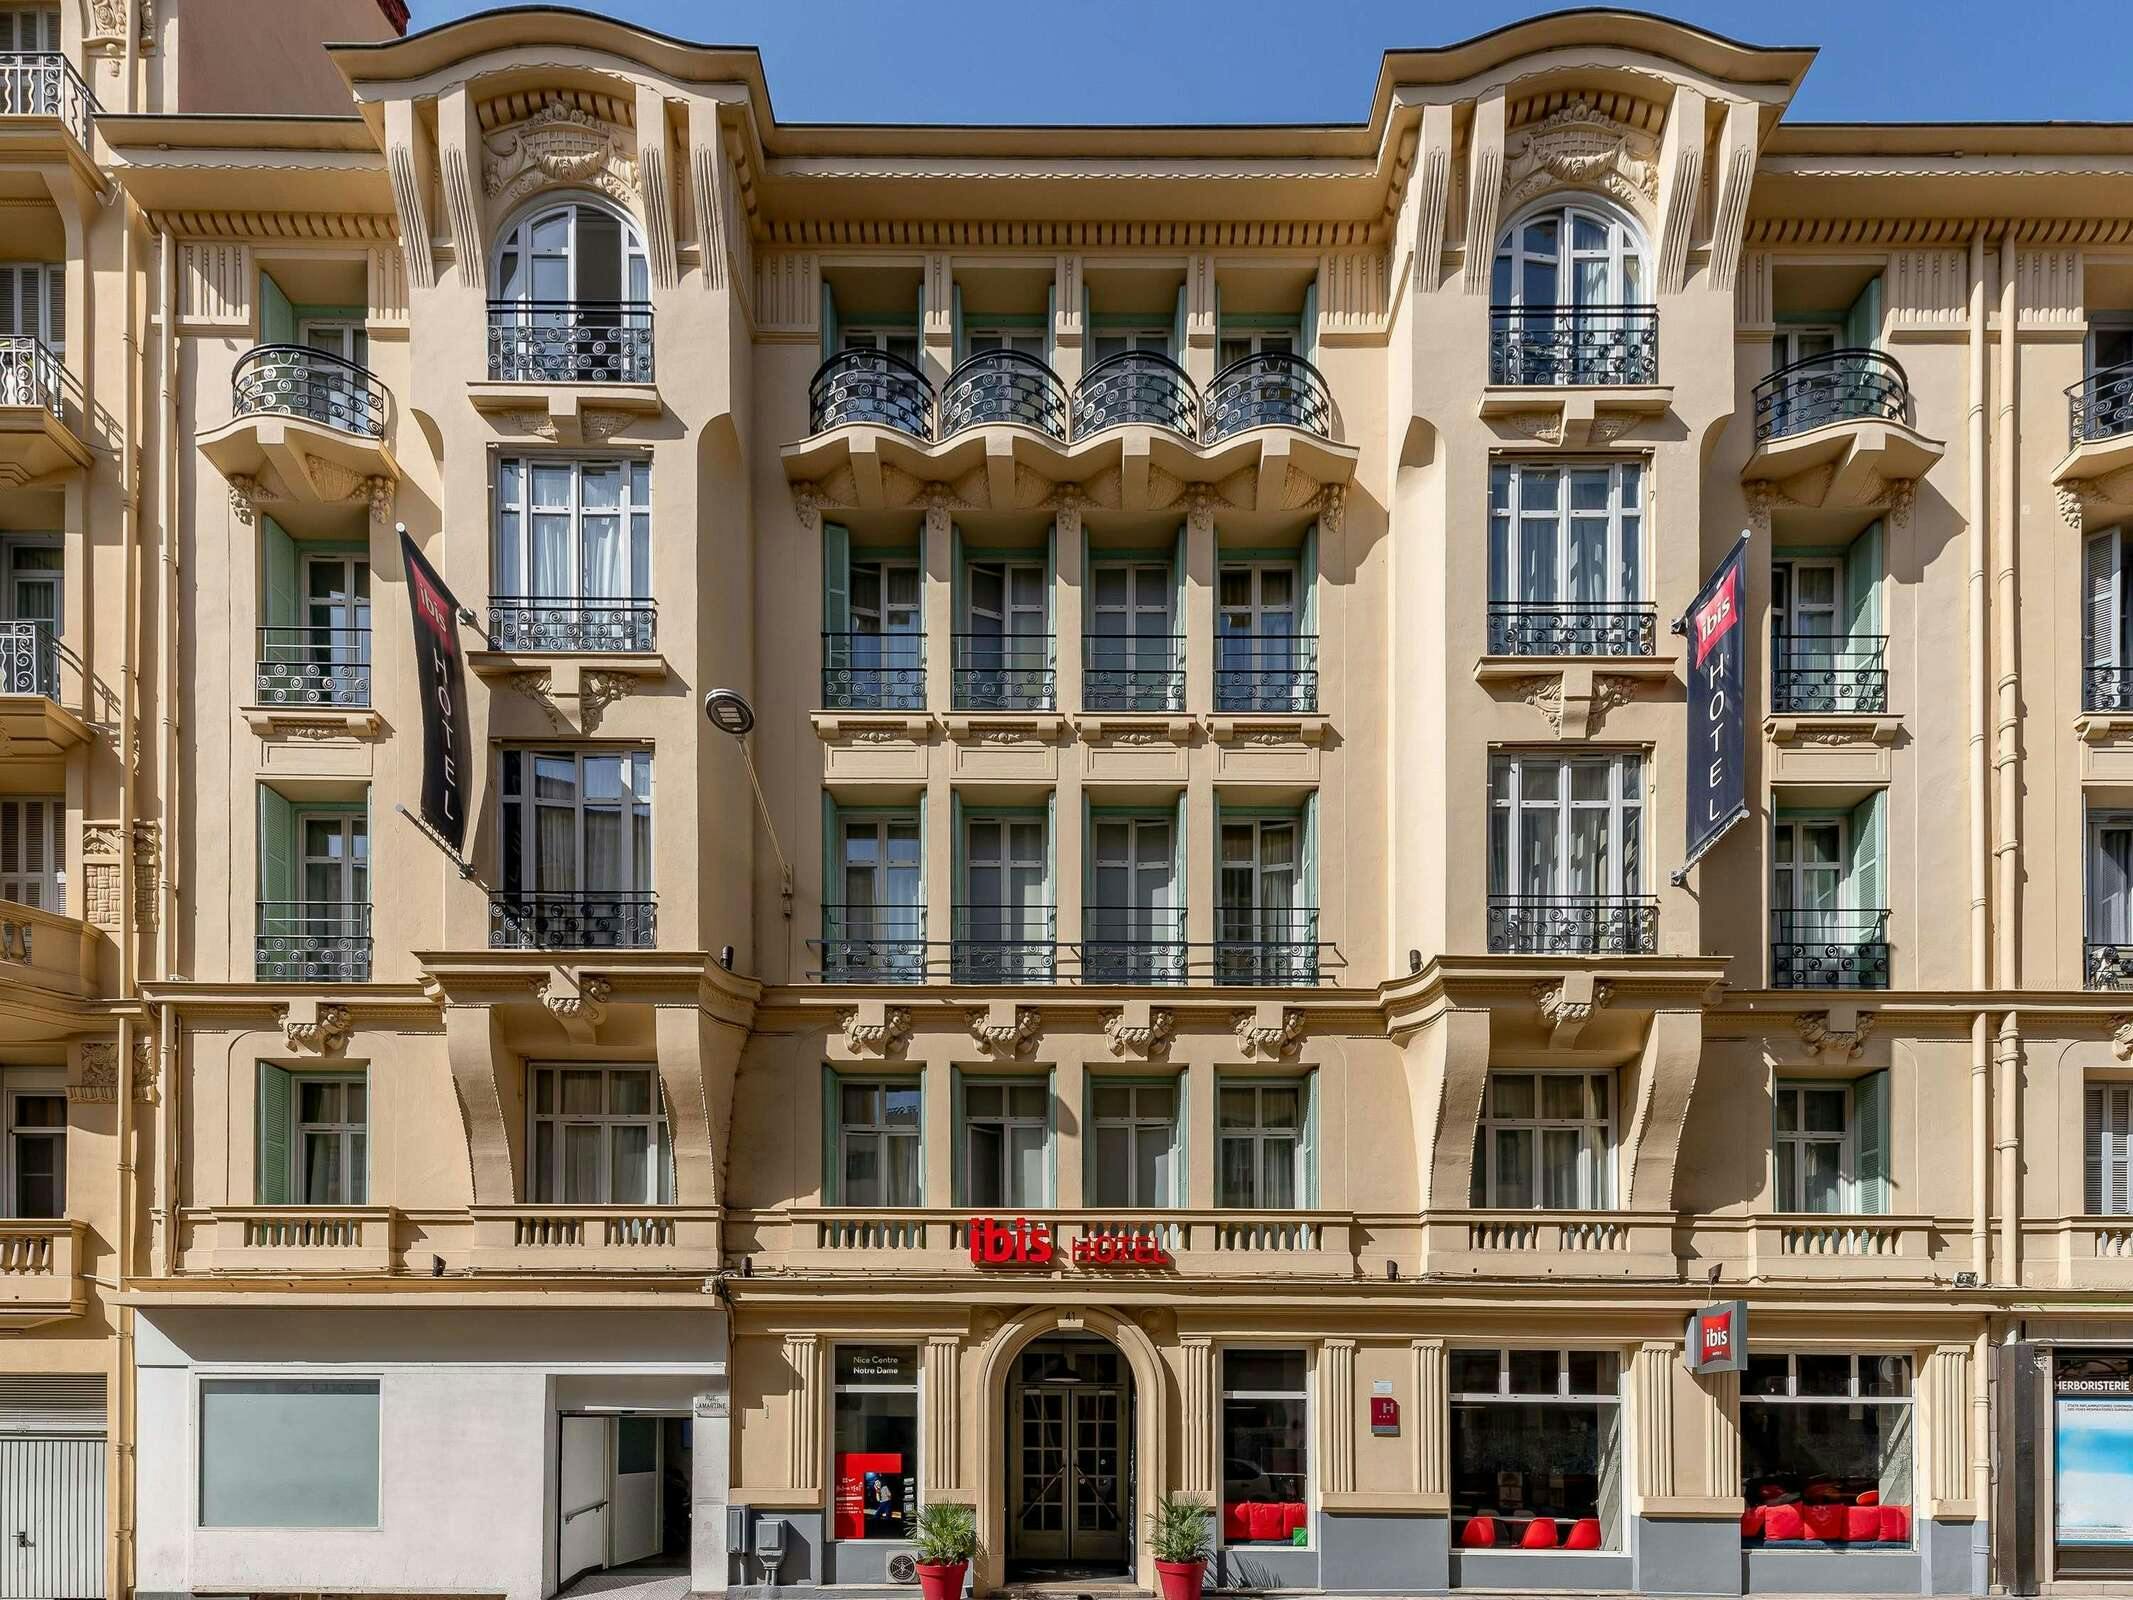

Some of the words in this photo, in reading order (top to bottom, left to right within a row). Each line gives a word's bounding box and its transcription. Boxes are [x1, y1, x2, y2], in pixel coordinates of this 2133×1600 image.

[419, 582, 447, 633] ibis
[1701, 596, 1731, 642] ibis
[433, 647, 456, 821] HOTEL
[1709, 652, 1725, 821] HOTEL
[969, 1217, 1053, 1263] ibis
[1072, 1236, 1168, 1263] HOTEL
[872, 1356, 898, 1364] Centre
[1706, 1327, 1728, 1348] ibis
[853, 1366, 875, 1374] Notre
[876, 1366, 898, 1374] Dame
[2054, 1380, 2130, 1391] HERBORISTERIE
